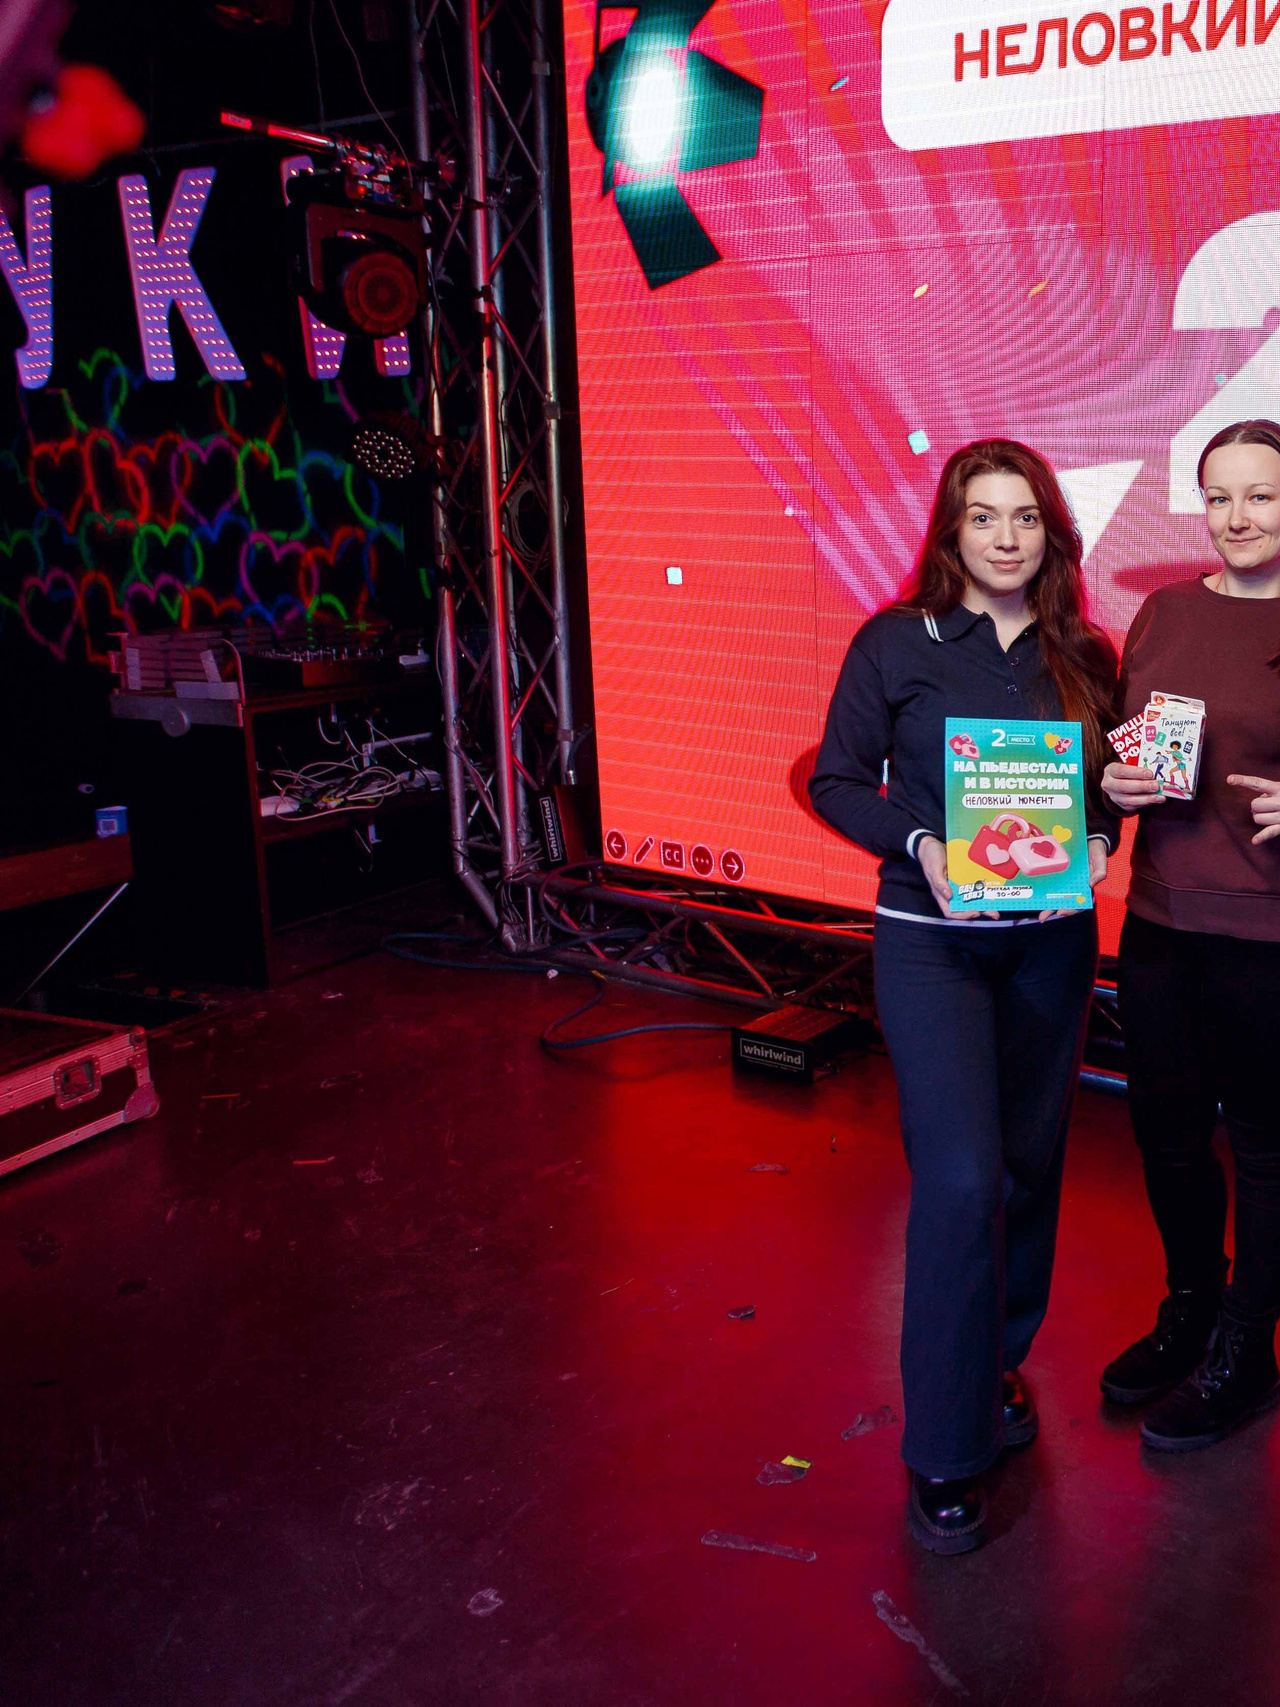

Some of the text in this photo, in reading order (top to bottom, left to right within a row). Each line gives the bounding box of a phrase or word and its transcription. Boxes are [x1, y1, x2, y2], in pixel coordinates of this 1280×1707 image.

[1161, 718, 1196, 729] Танцуют
[991, 729, 1006, 747] 2
[953, 761, 1078, 774] НА ПЬЕДЕСТАЛЕ
[964, 777, 1069, 790] И В ИСТОРИИ
[966, 795, 1012, 805] НЕЛОВКИЙ
[665, 849, 680, 862] CC
[743, 1045, 801, 1065] whirlwind
